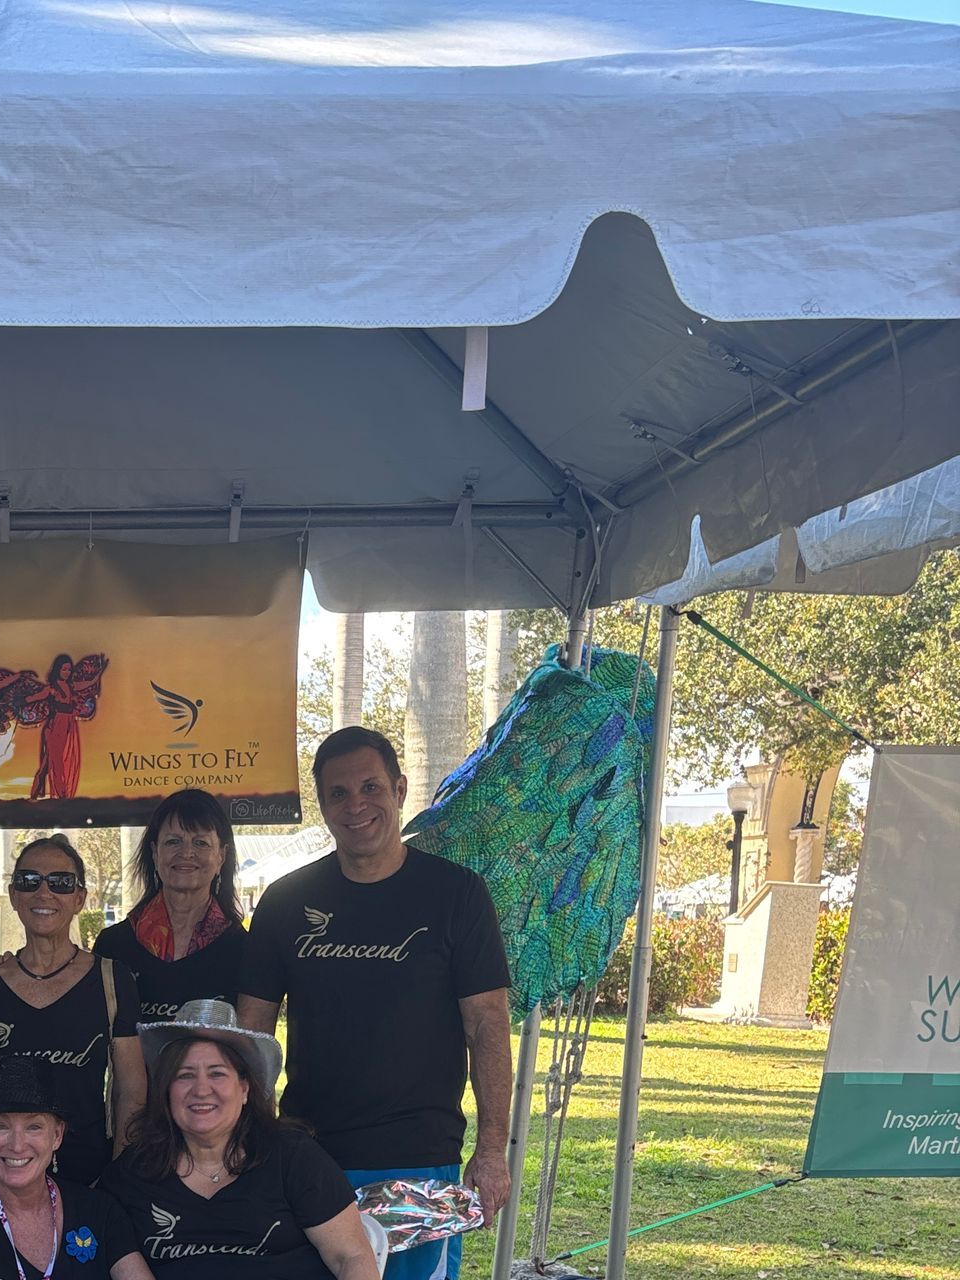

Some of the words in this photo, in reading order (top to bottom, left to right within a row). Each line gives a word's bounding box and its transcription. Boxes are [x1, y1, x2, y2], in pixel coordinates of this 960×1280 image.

[109, 752, 181, 771] WINGS
[188, 752, 218, 769] TO
[224, 749, 259, 769] FLY
[123, 776, 169, 787] DANCE
[174, 774, 244, 785] COMPANY
[295, 927, 429, 962] Transcend
